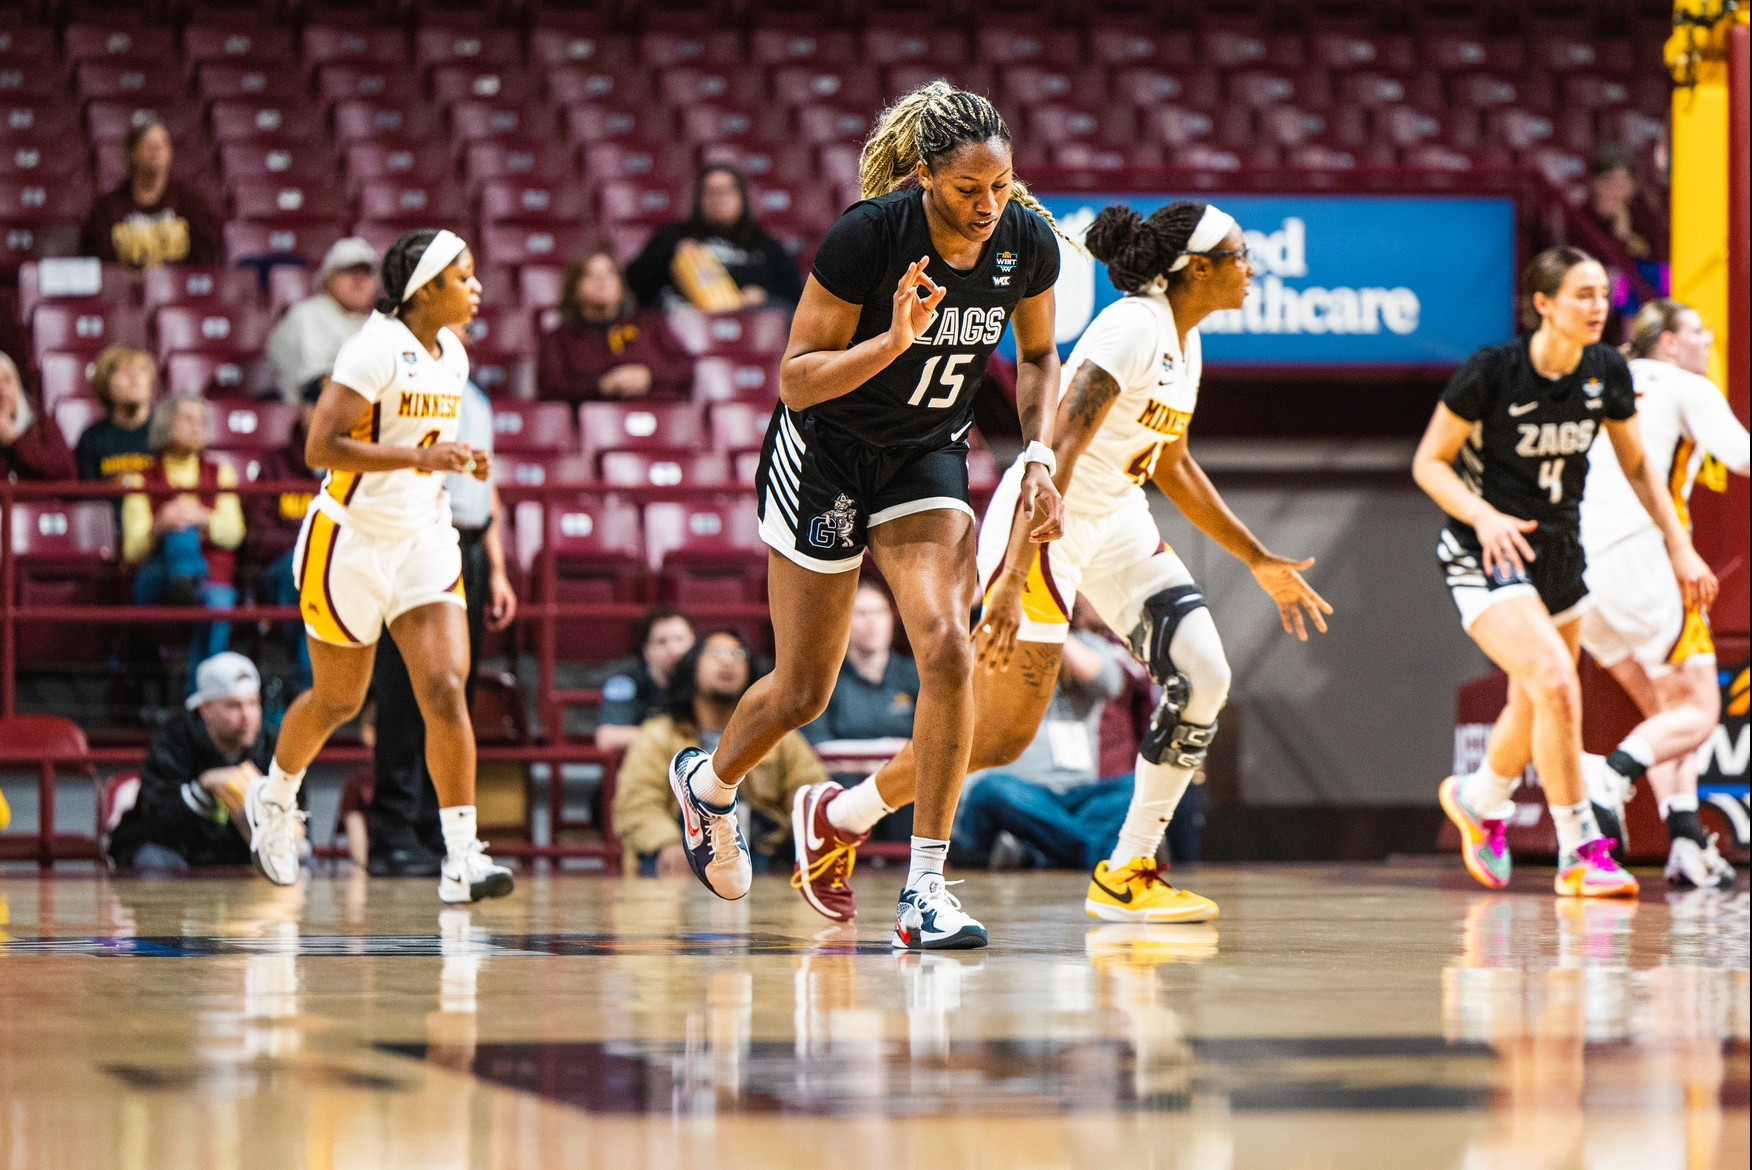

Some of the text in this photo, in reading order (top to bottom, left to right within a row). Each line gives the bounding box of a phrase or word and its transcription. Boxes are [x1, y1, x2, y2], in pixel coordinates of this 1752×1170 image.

[907, 354, 976, 409] 15
[1515, 418, 1596, 458] ZAGS
[1538, 458, 1566, 505] 4
